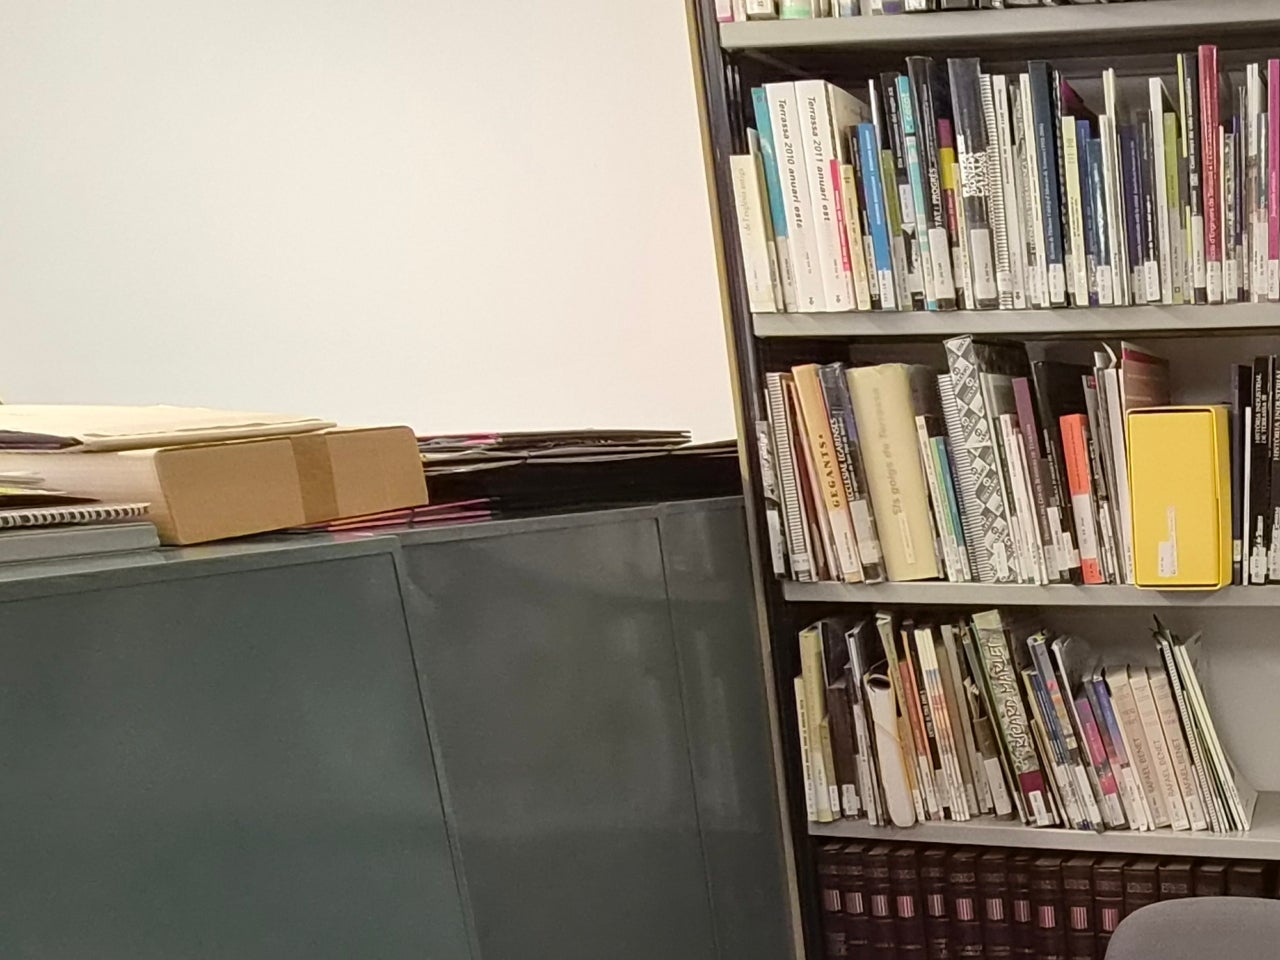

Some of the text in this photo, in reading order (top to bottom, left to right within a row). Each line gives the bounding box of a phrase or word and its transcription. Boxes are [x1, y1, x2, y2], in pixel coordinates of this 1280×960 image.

[778, 98, 791, 139] Terrassa
[807, 96, 820, 137] Terrassa
[784, 142, 795, 165] 2010
[813, 140, 823, 162] 2011
[787, 168, 800, 203] anuari
[816, 166, 829, 201] anuari
[818, 441, 840, 508] GEGANTS
